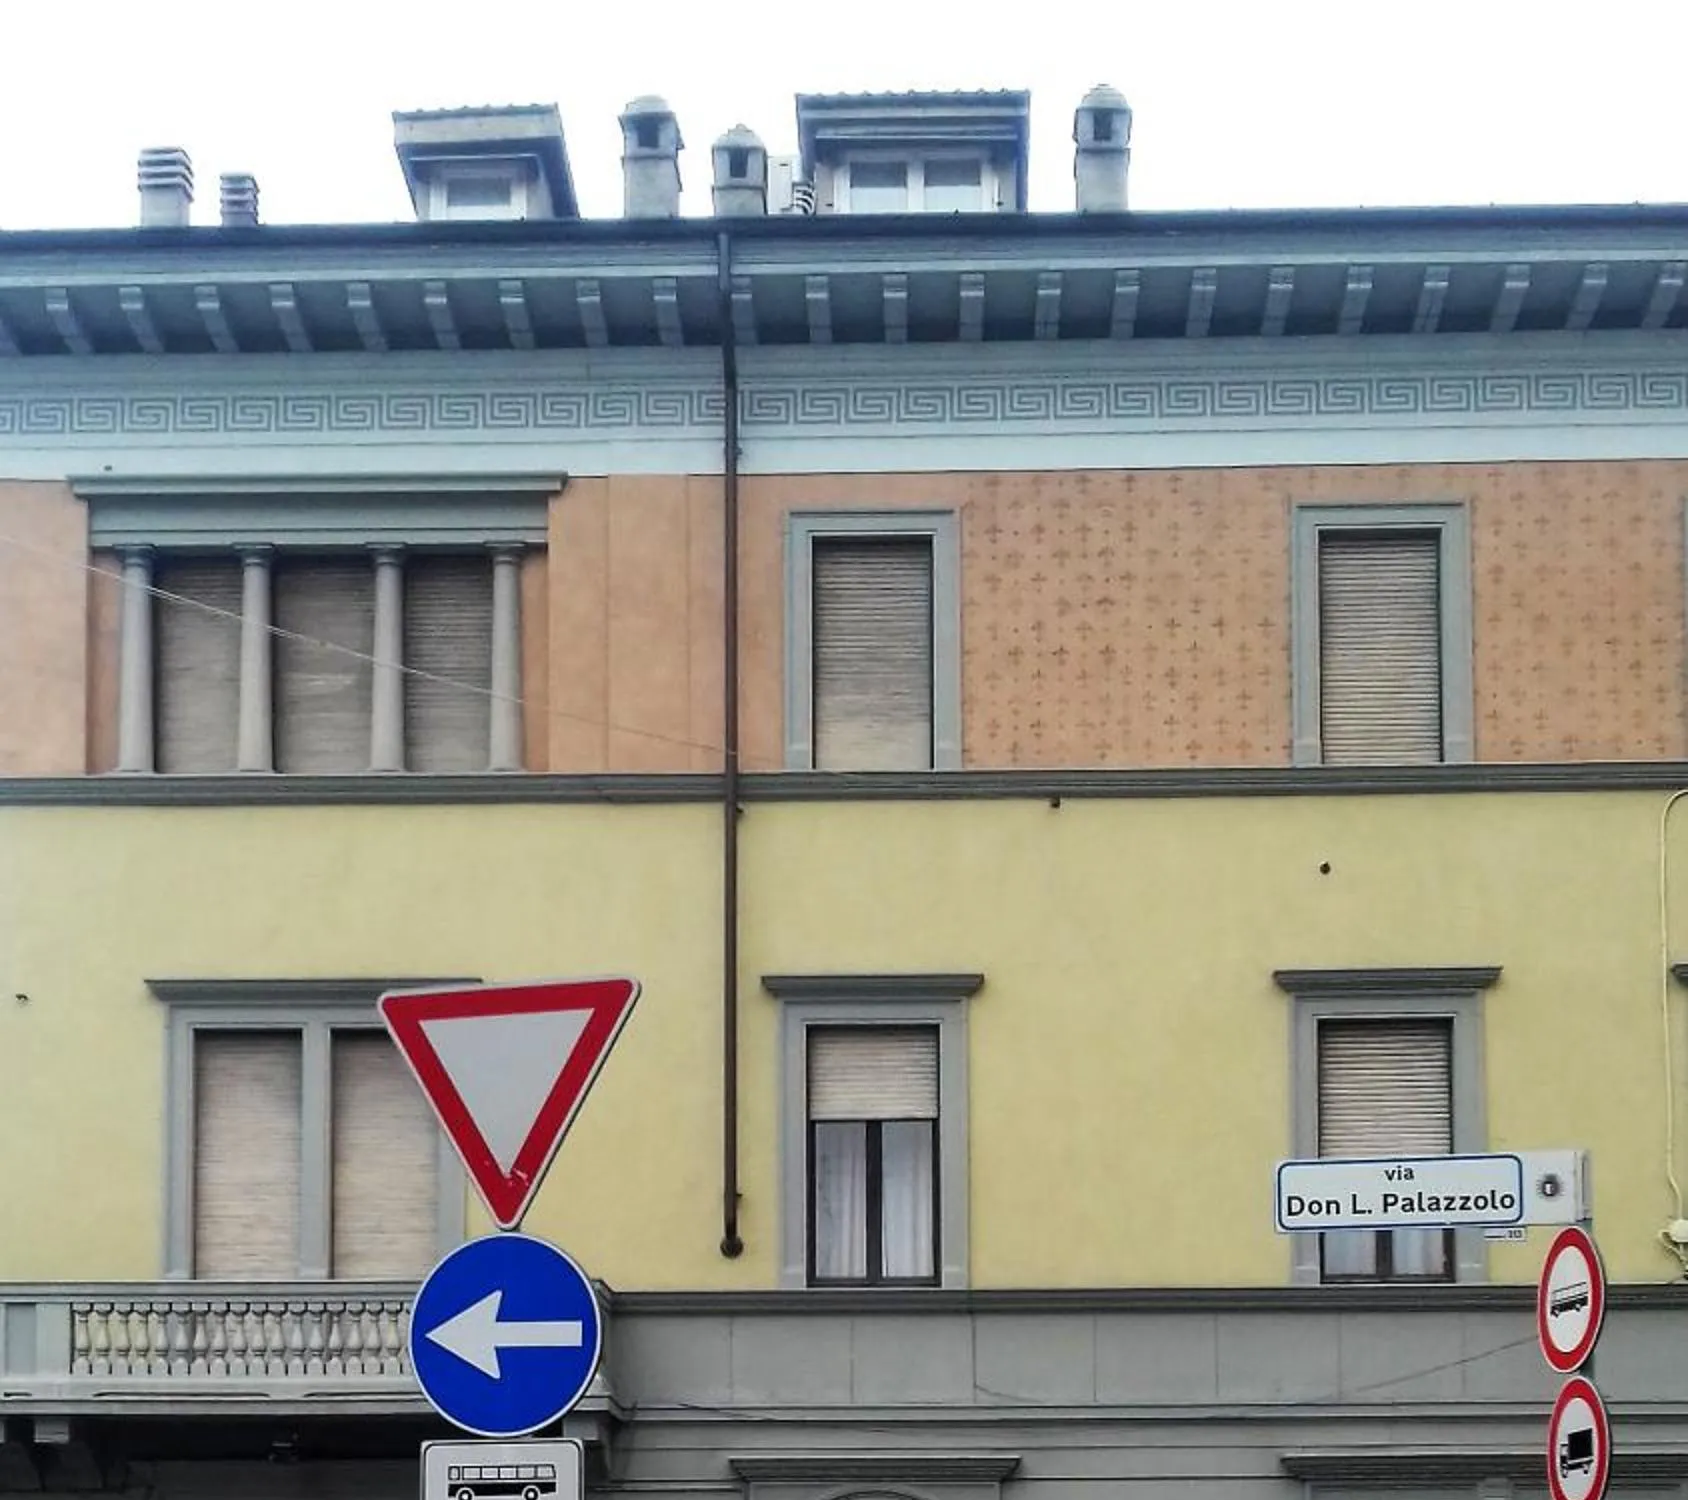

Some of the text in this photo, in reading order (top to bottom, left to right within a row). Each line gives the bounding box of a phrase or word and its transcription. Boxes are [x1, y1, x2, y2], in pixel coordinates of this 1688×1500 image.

[1384, 1165, 1415, 1181] via
[1286, 1189, 1516, 1217] Don L. Palazzolo
